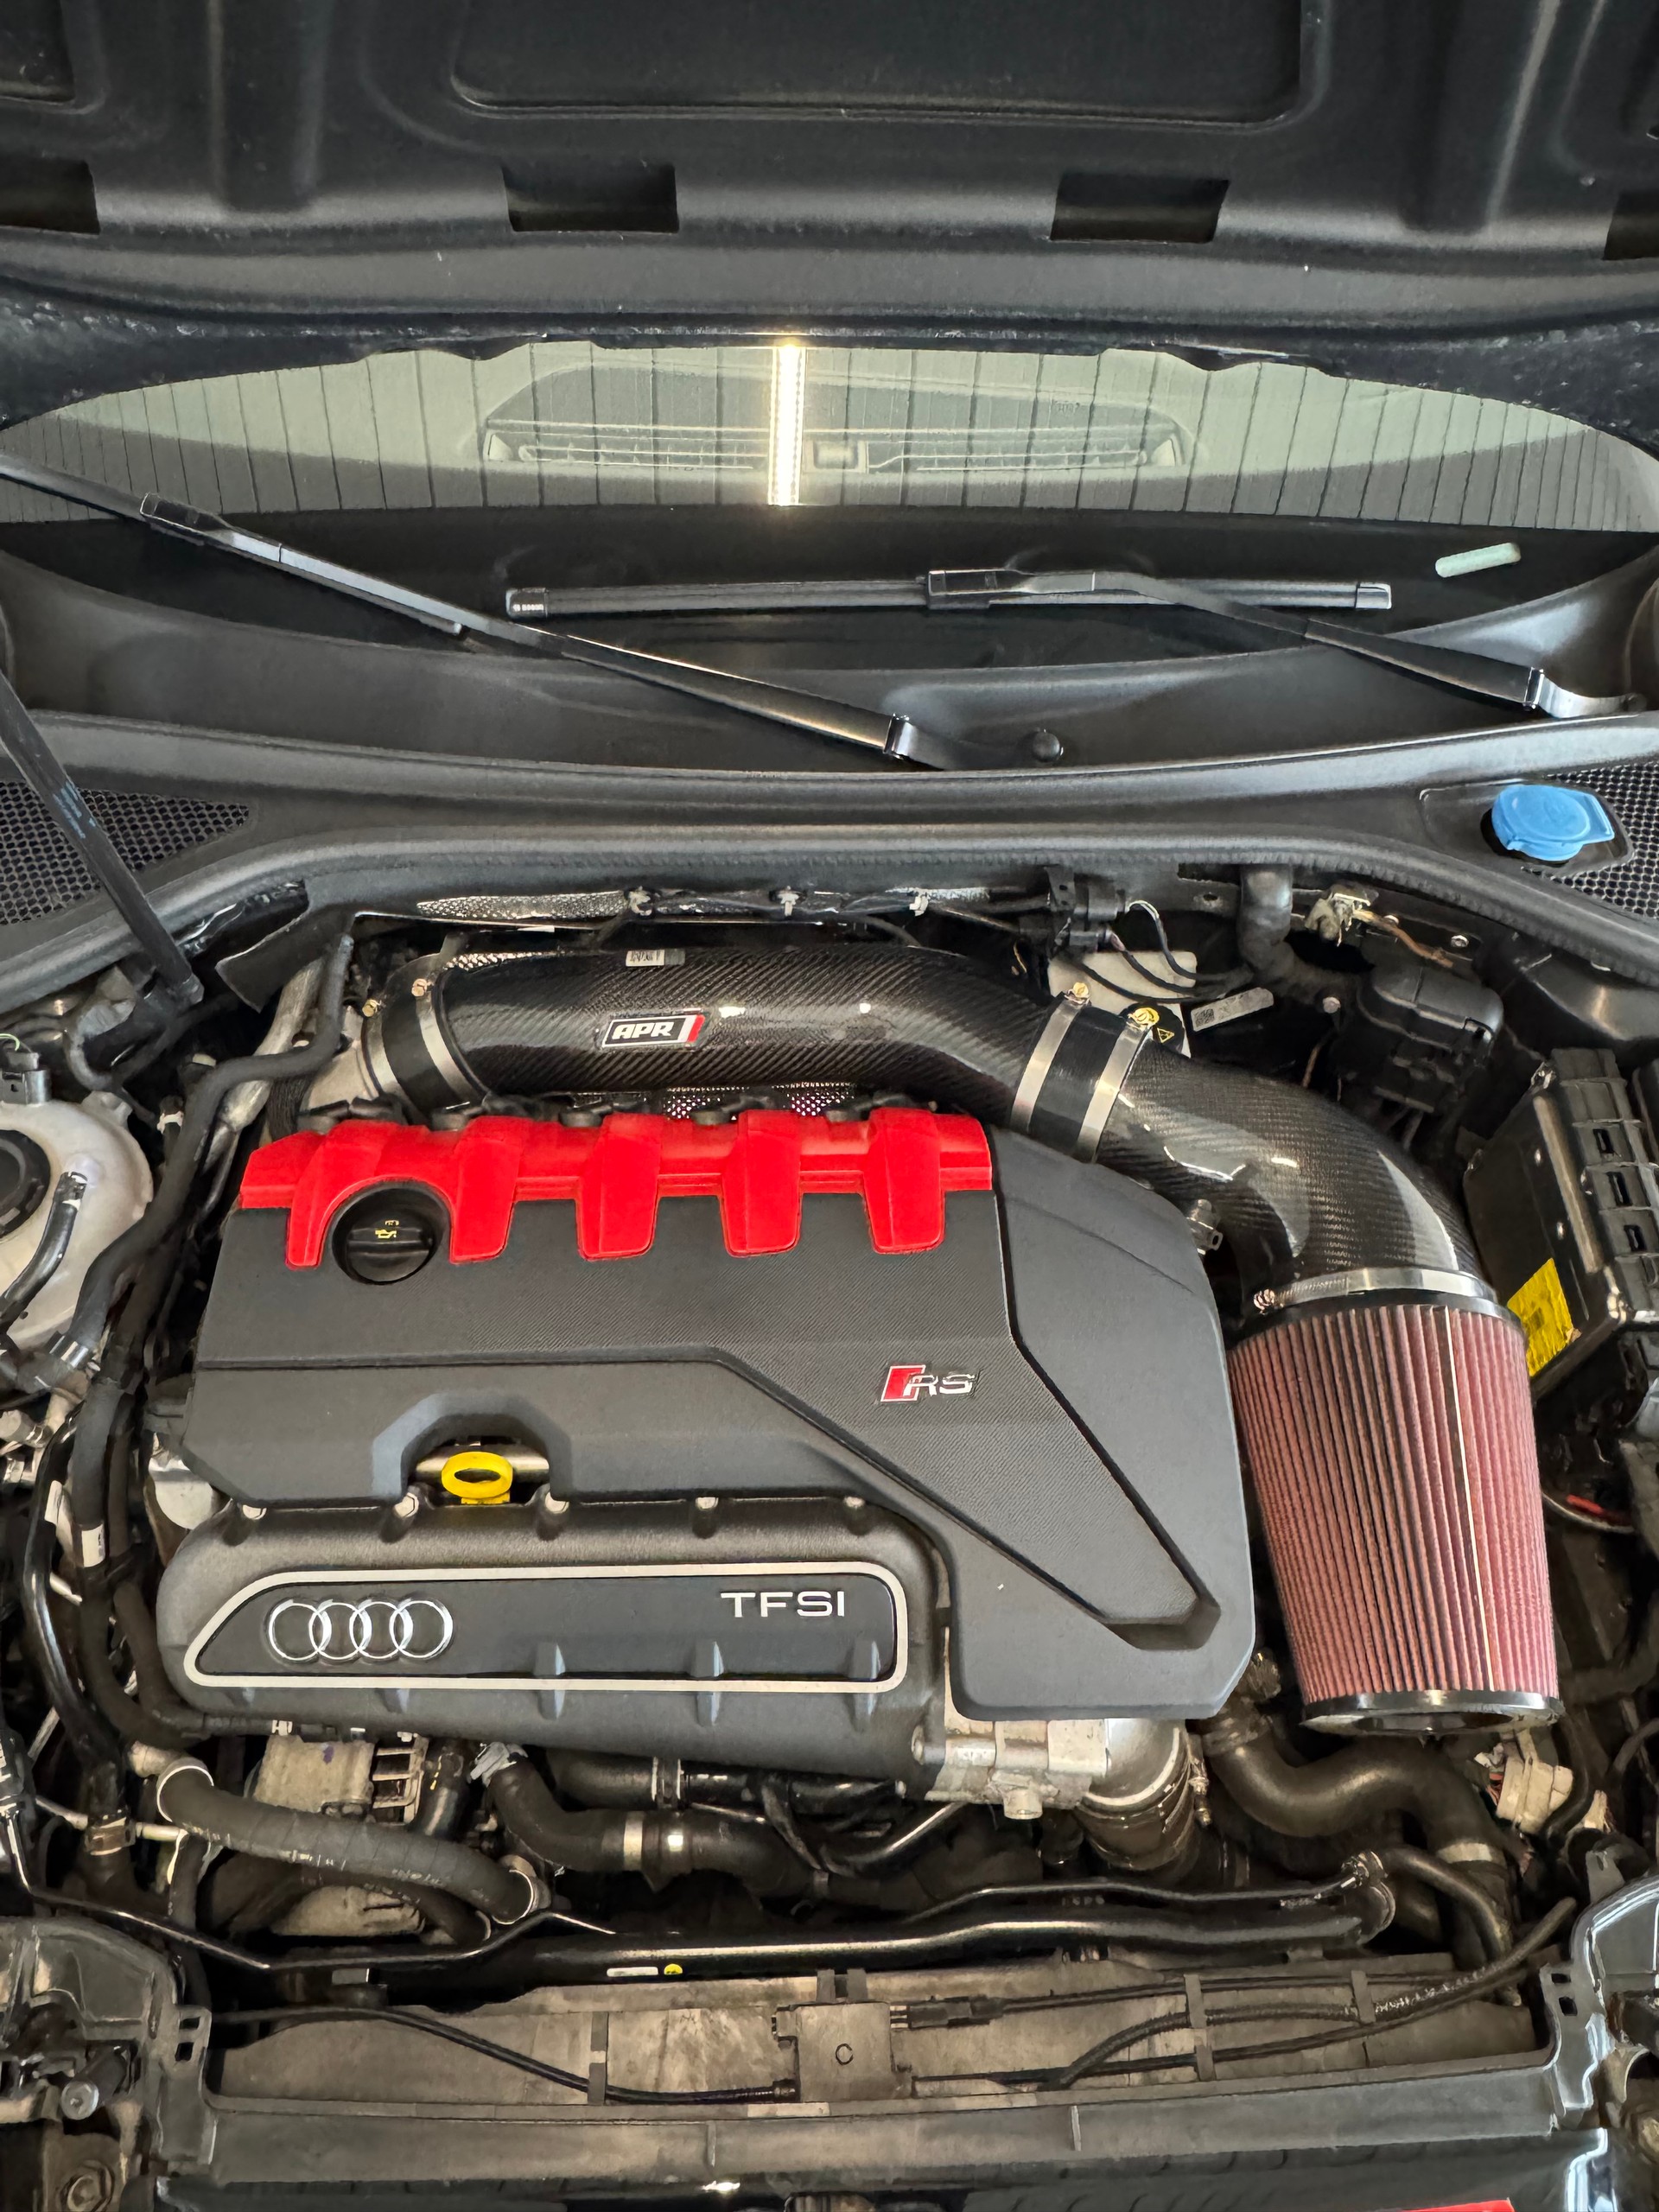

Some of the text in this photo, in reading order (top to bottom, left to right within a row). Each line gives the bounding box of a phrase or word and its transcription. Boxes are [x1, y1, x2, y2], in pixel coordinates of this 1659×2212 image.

[612, 1021, 674, 1039] APR
[899, 1371, 976, 1397] RS
[721, 1591, 845, 1618] TFSI
